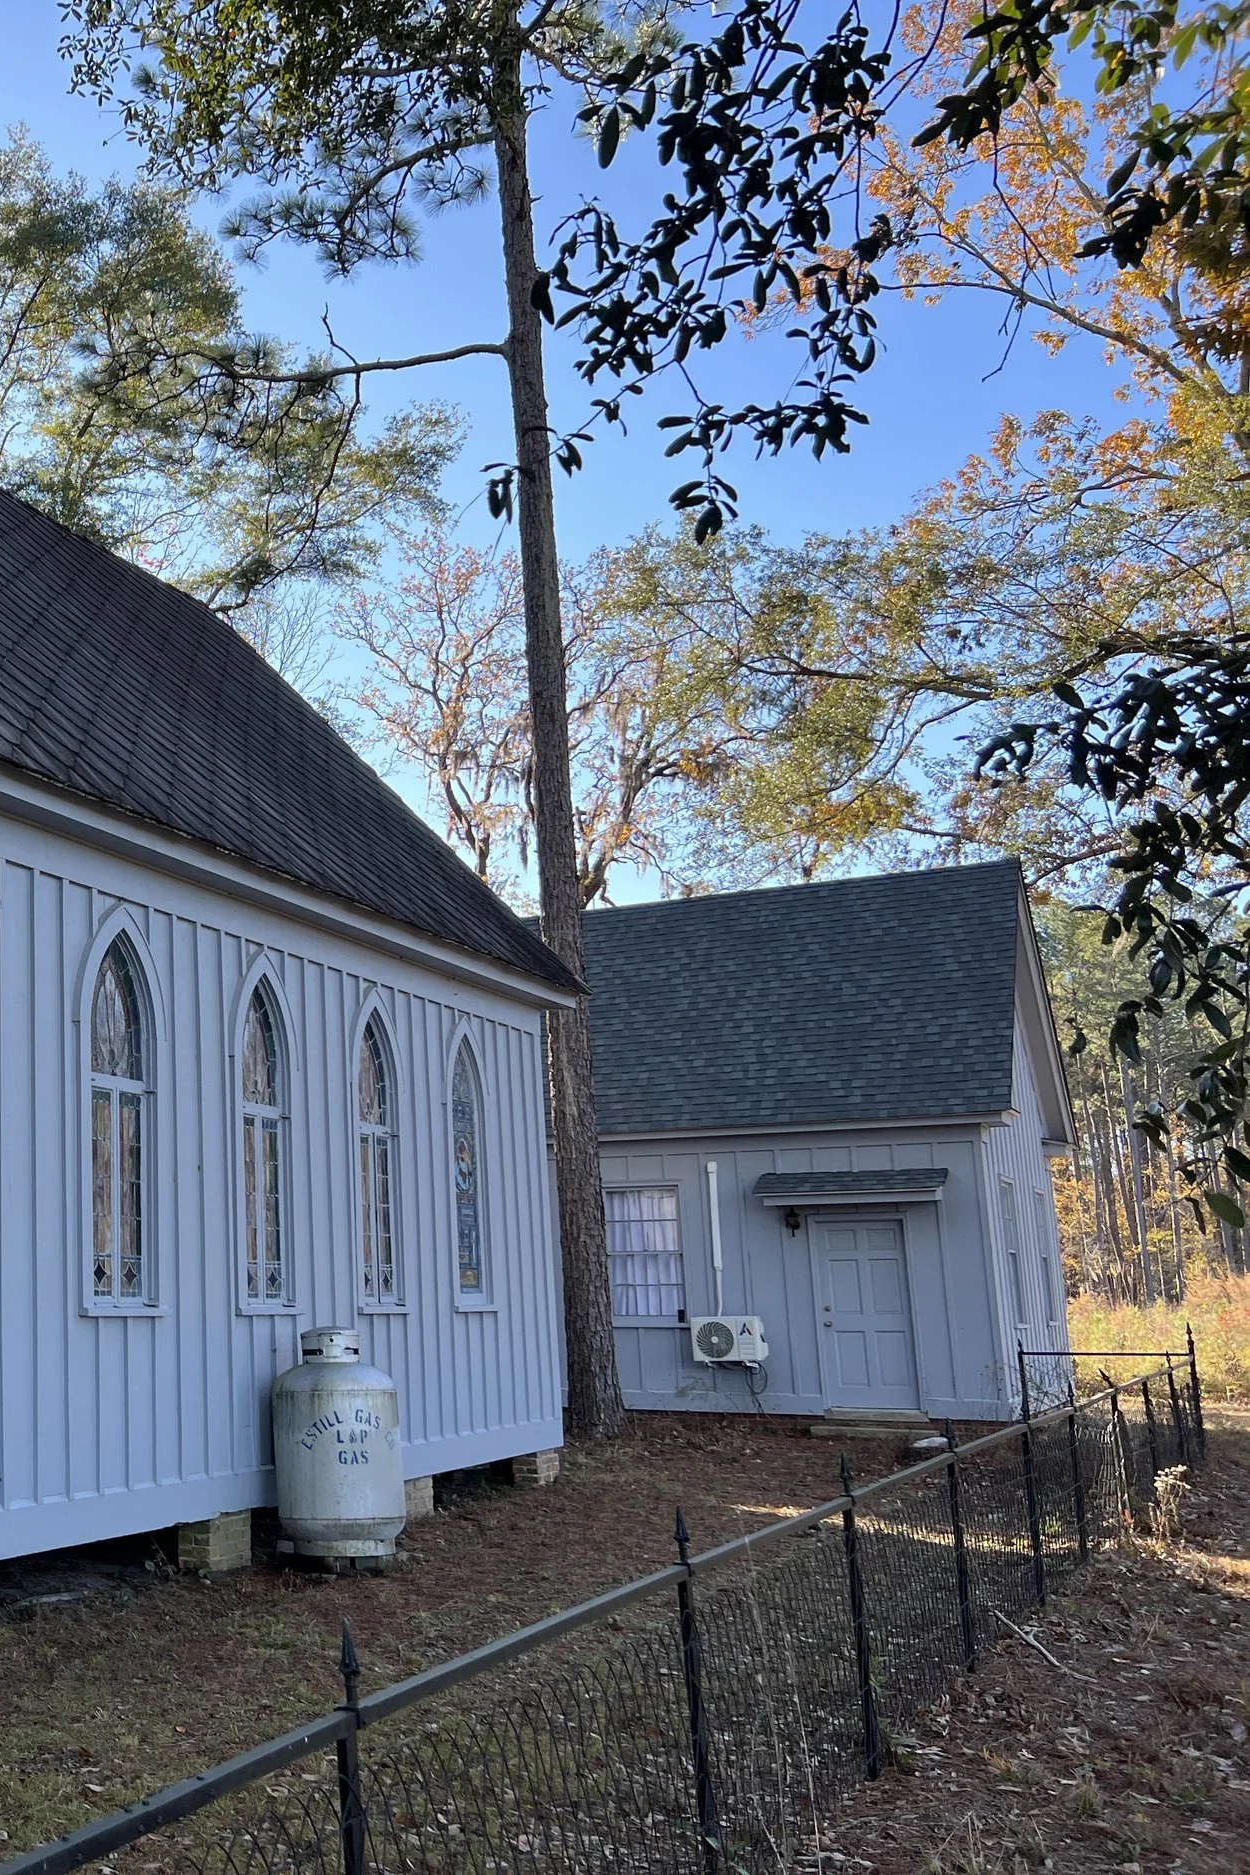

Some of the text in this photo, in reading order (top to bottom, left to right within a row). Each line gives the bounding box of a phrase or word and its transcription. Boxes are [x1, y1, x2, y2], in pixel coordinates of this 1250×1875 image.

[301, 1411, 344, 1450] ESTILL
[355, 1409, 381, 1429] GAS
[338, 1450, 369, 1465] GAS
